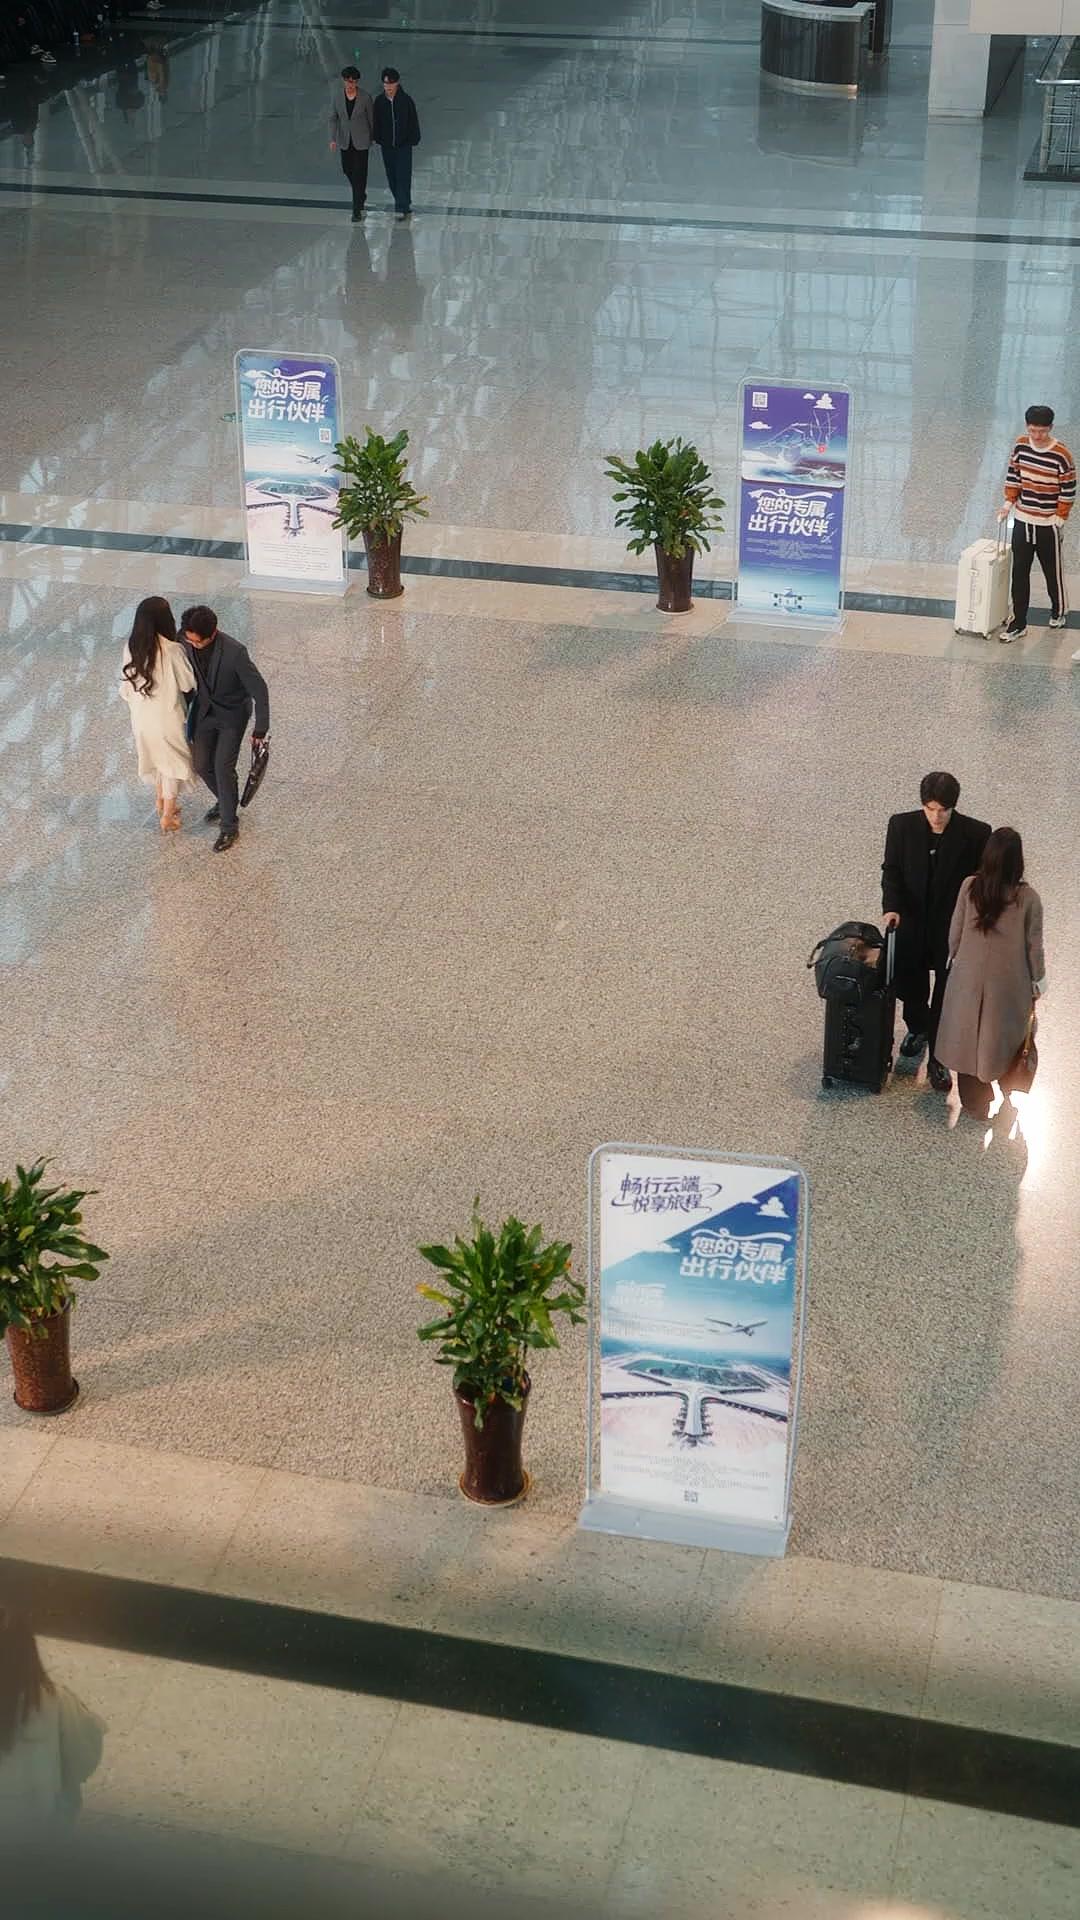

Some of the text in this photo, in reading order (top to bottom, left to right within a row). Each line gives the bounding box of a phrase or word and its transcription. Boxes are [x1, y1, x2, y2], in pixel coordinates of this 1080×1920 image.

[254, 380, 322, 401] 您的专属
[247, 399, 326, 423] 出行伙伴
[756, 496, 827, 518] 您的专属
[748, 516, 829, 537] 出行伙伴
[620, 1173, 700, 1199] 畅行云端
[633, 1194, 704, 1213] 悦享旅程
[691, 1237, 784, 1262] 您的专属
[680, 1256, 788, 1284] 出行伙伴
